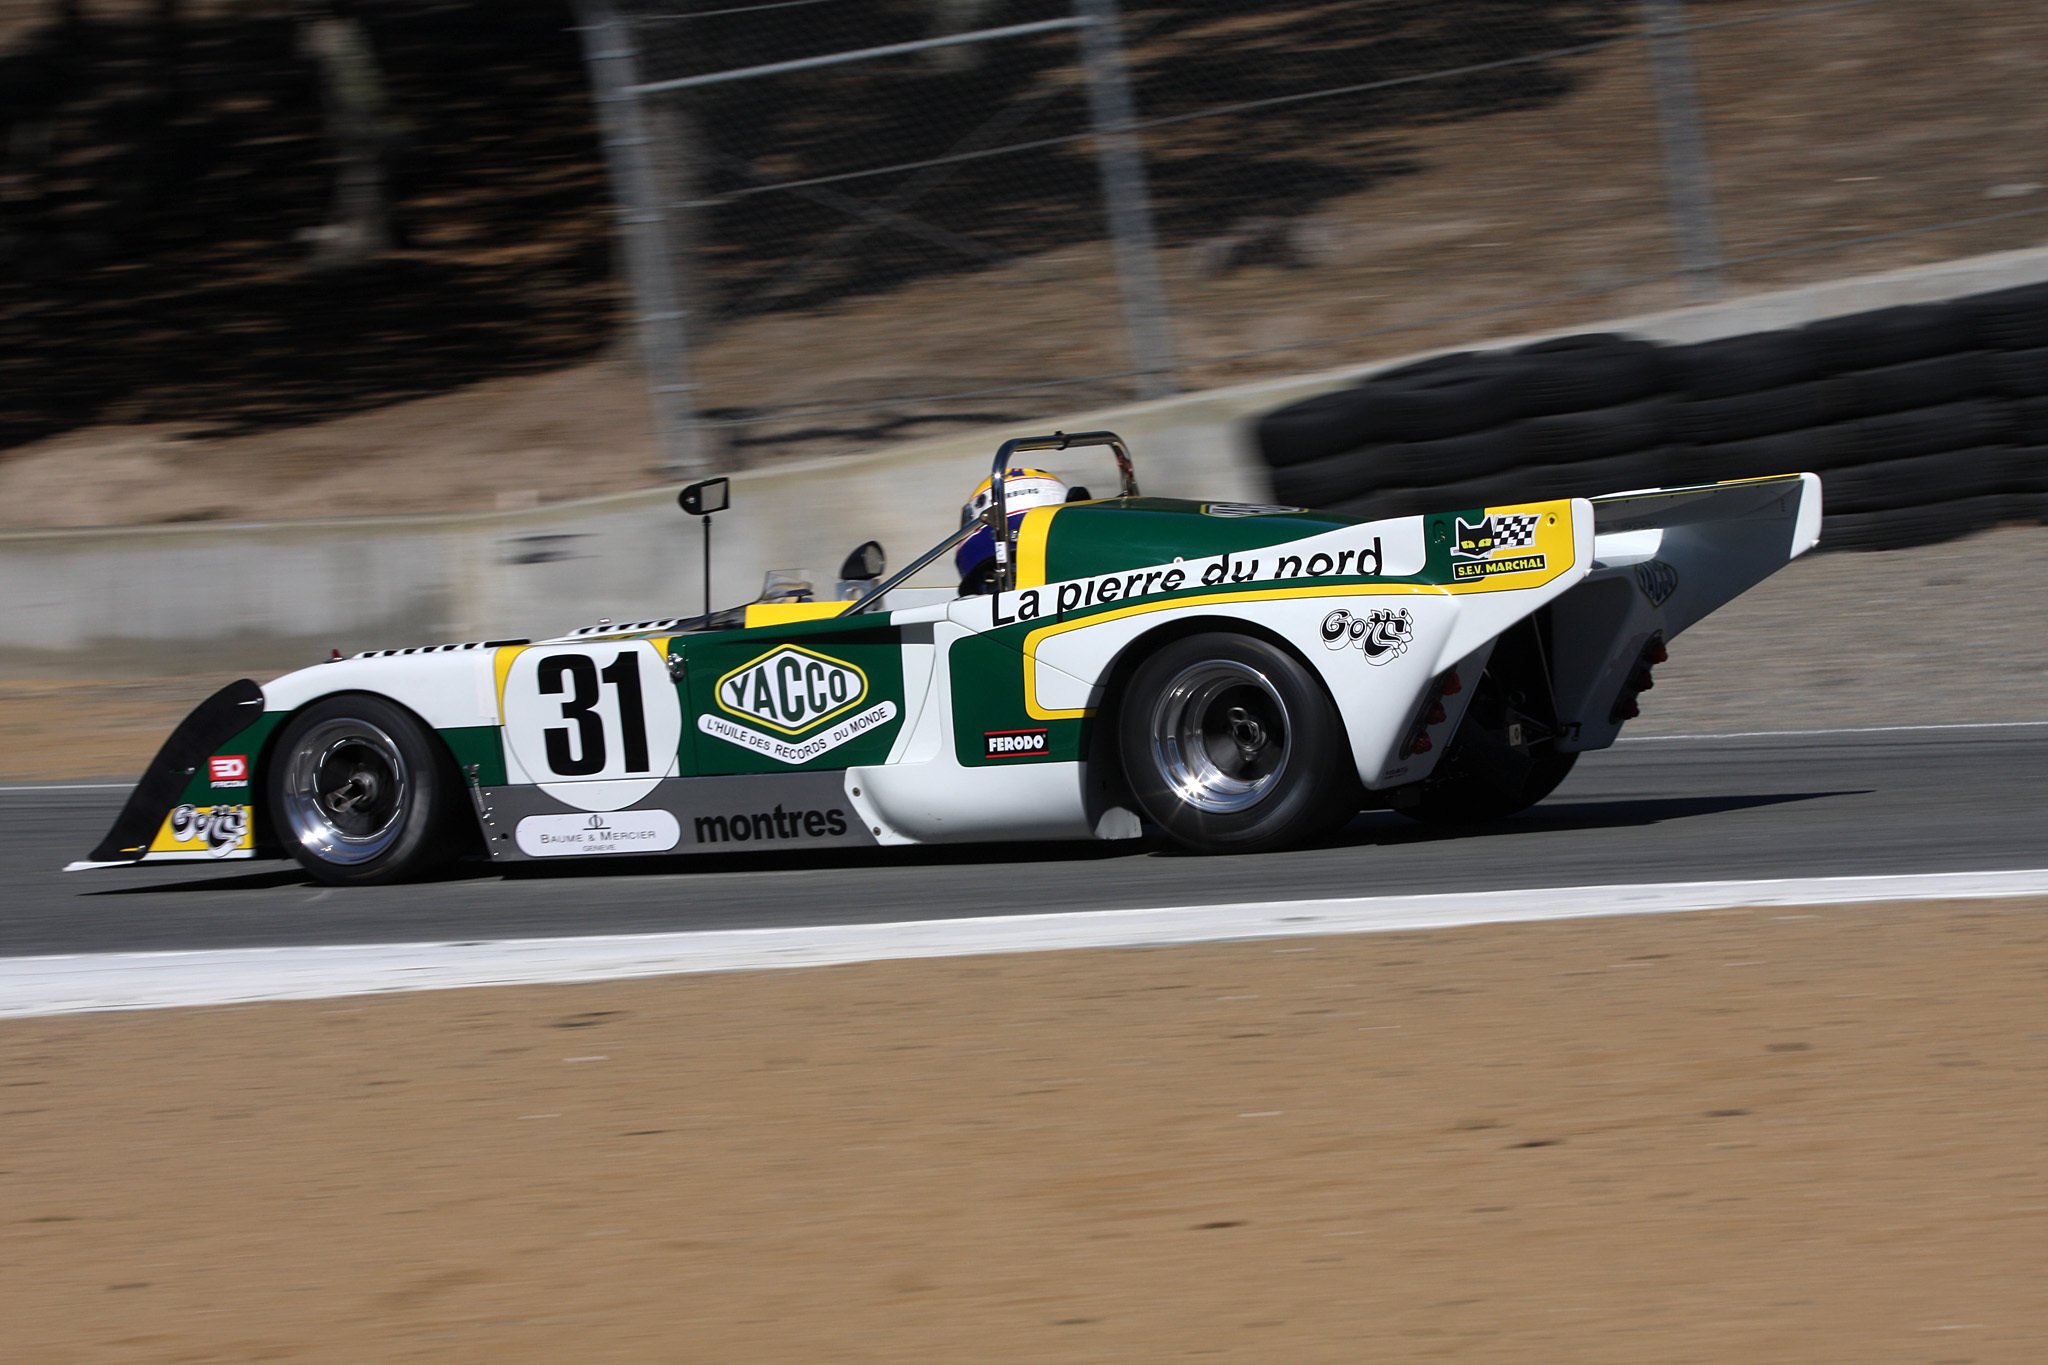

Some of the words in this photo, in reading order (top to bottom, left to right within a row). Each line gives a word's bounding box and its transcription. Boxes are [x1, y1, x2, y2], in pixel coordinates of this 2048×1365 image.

[992, 590, 1040, 627] La
[1057, 569, 1186, 623] pierre
[1201, 554, 1259, 586] du
[1274, 537, 1383, 579] nord
[1458, 566, 1484, 576] S.E.V.
[1486, 558, 1544, 574] MARCHAL
[729, 656, 848, 722] YACCO
[537, 651, 650, 776] 31
[706, 718, 747, 743] L'HUILE
[749, 735, 771, 752] DES
[774, 738, 828, 760] RECORDS
[833, 727, 850, 743] DU
[850, 706, 888, 733] MONDE
[989, 734, 1044, 753] FERODO
[588, 834, 596, 842] &
[694, 803, 848, 844] montres
